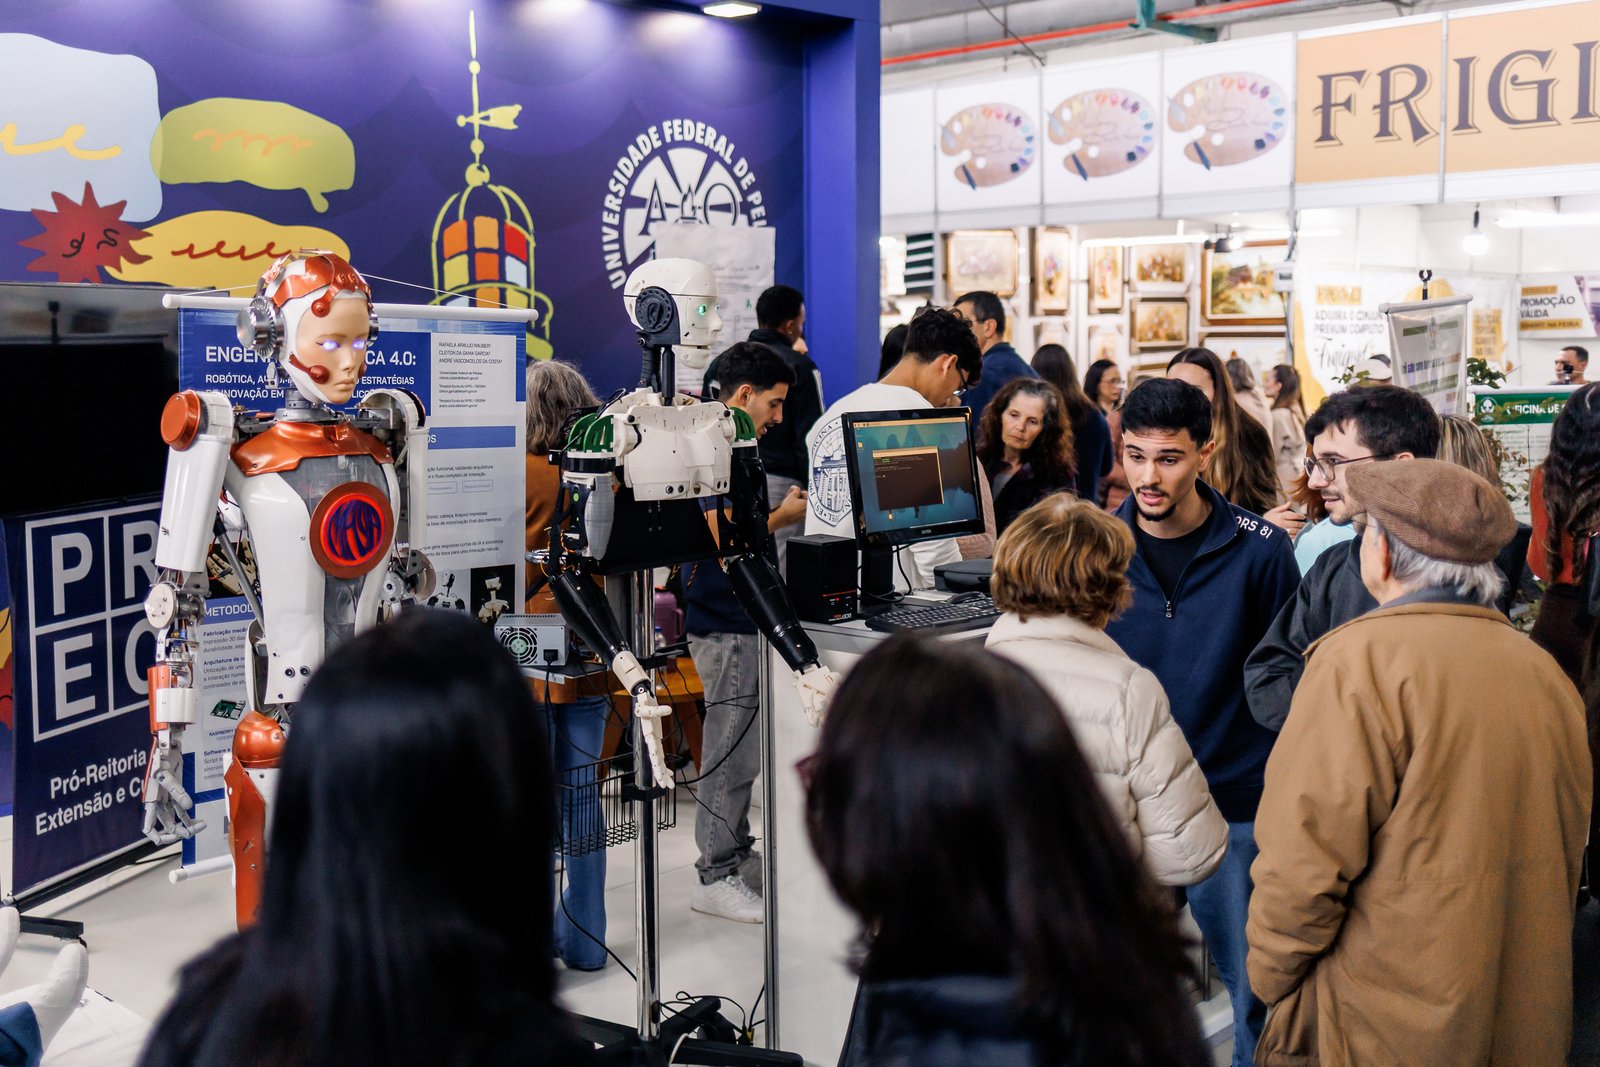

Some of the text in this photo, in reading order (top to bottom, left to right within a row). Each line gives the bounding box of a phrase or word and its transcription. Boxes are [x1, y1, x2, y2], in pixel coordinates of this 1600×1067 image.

[602, 125, 662, 290] UNIVERSIDADE
[662, 118, 736, 165] FEDERAL
[732, 157, 756, 191] DE
[1520, 295, 1575, 308] PROMOÇÃO
[365, 350, 386, 366] CA
[389, 350, 416, 366] 4.0:
[205, 372, 256, 386] ROBÓTICA,
[361, 374, 415, 385] ESTRATÉGIAS
[271, 389, 284, 399] EM
[1259, 525, 1273, 539] 81
[205, 603, 254, 617] METODOL
[203, 629, 231, 637] Fabricação
[50, 748, 147, 800] Pró-Reitoria
[35, 791, 112, 836] Extensão
[116, 786, 126, 803] e
